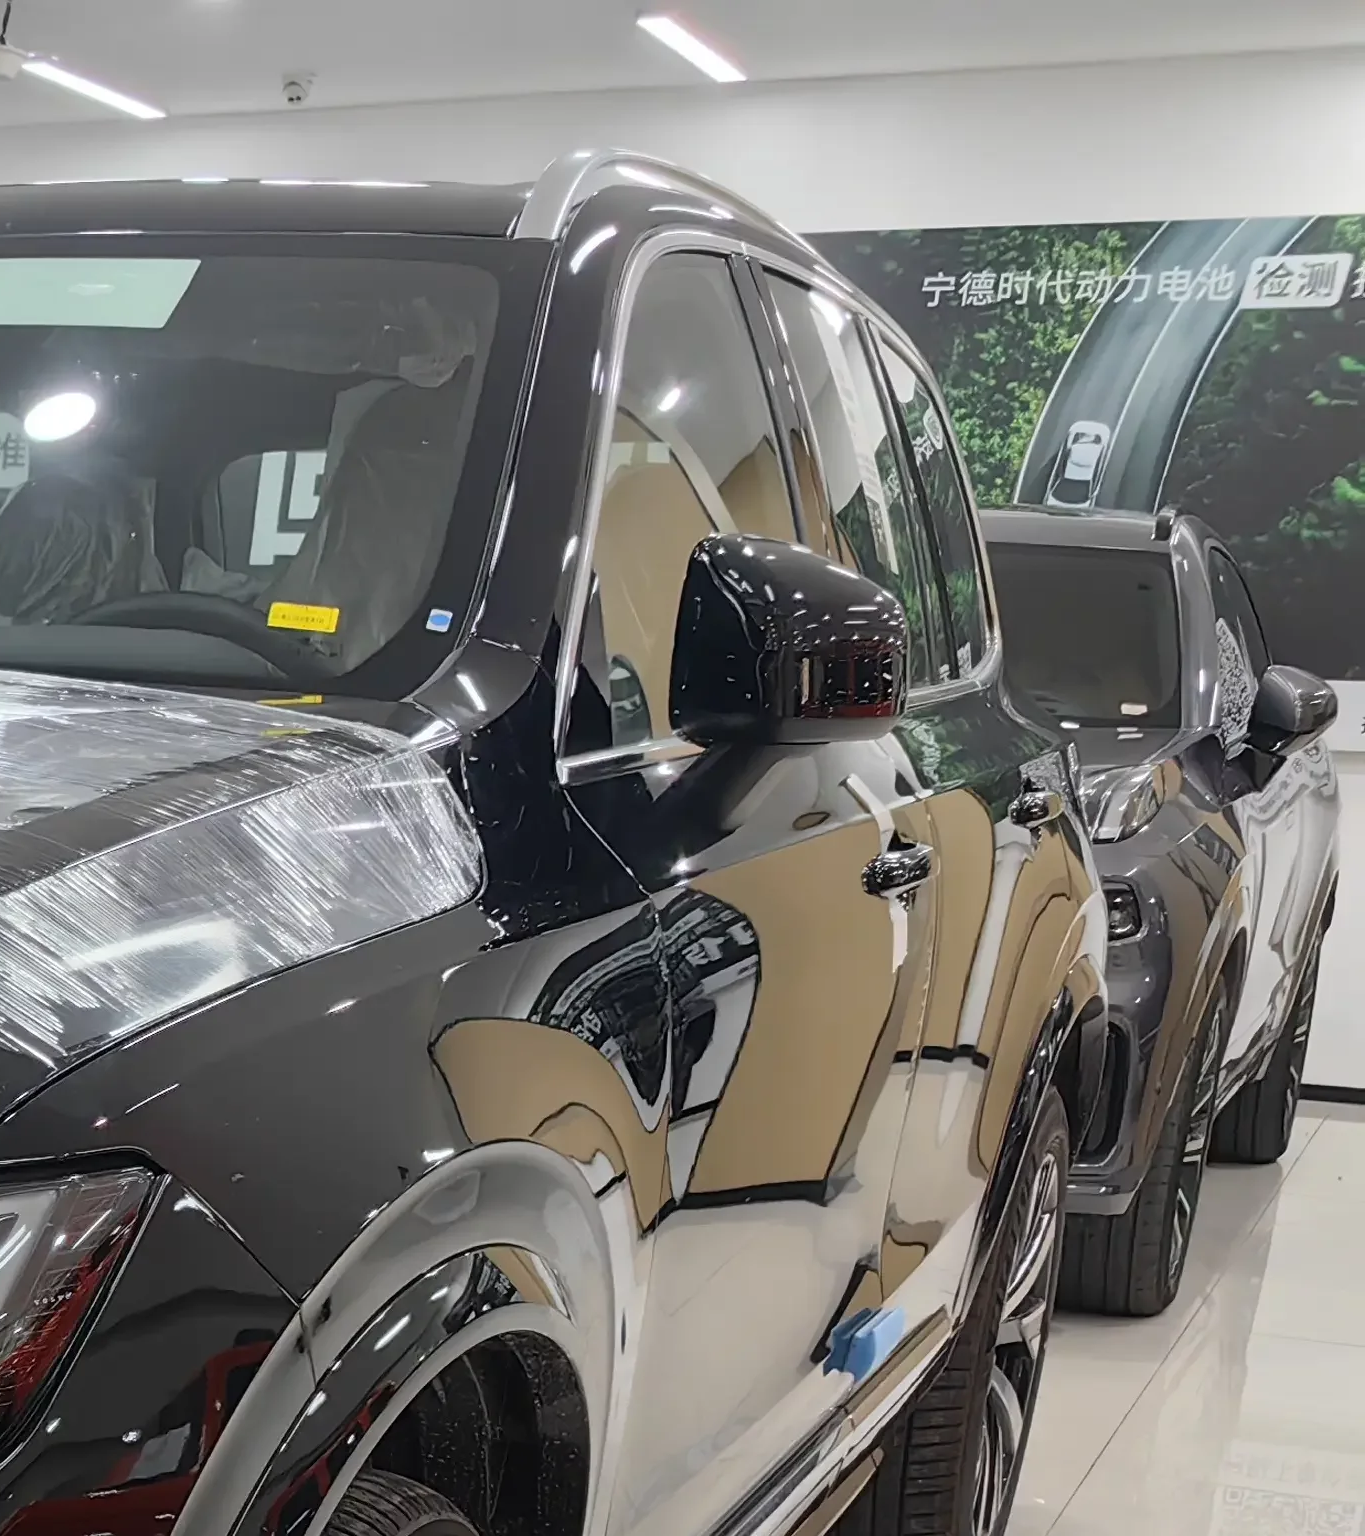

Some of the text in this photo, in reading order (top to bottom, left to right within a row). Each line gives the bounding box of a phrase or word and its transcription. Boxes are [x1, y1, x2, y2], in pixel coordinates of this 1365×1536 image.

[921, 269, 1235, 307] 宁德时代动力电池
